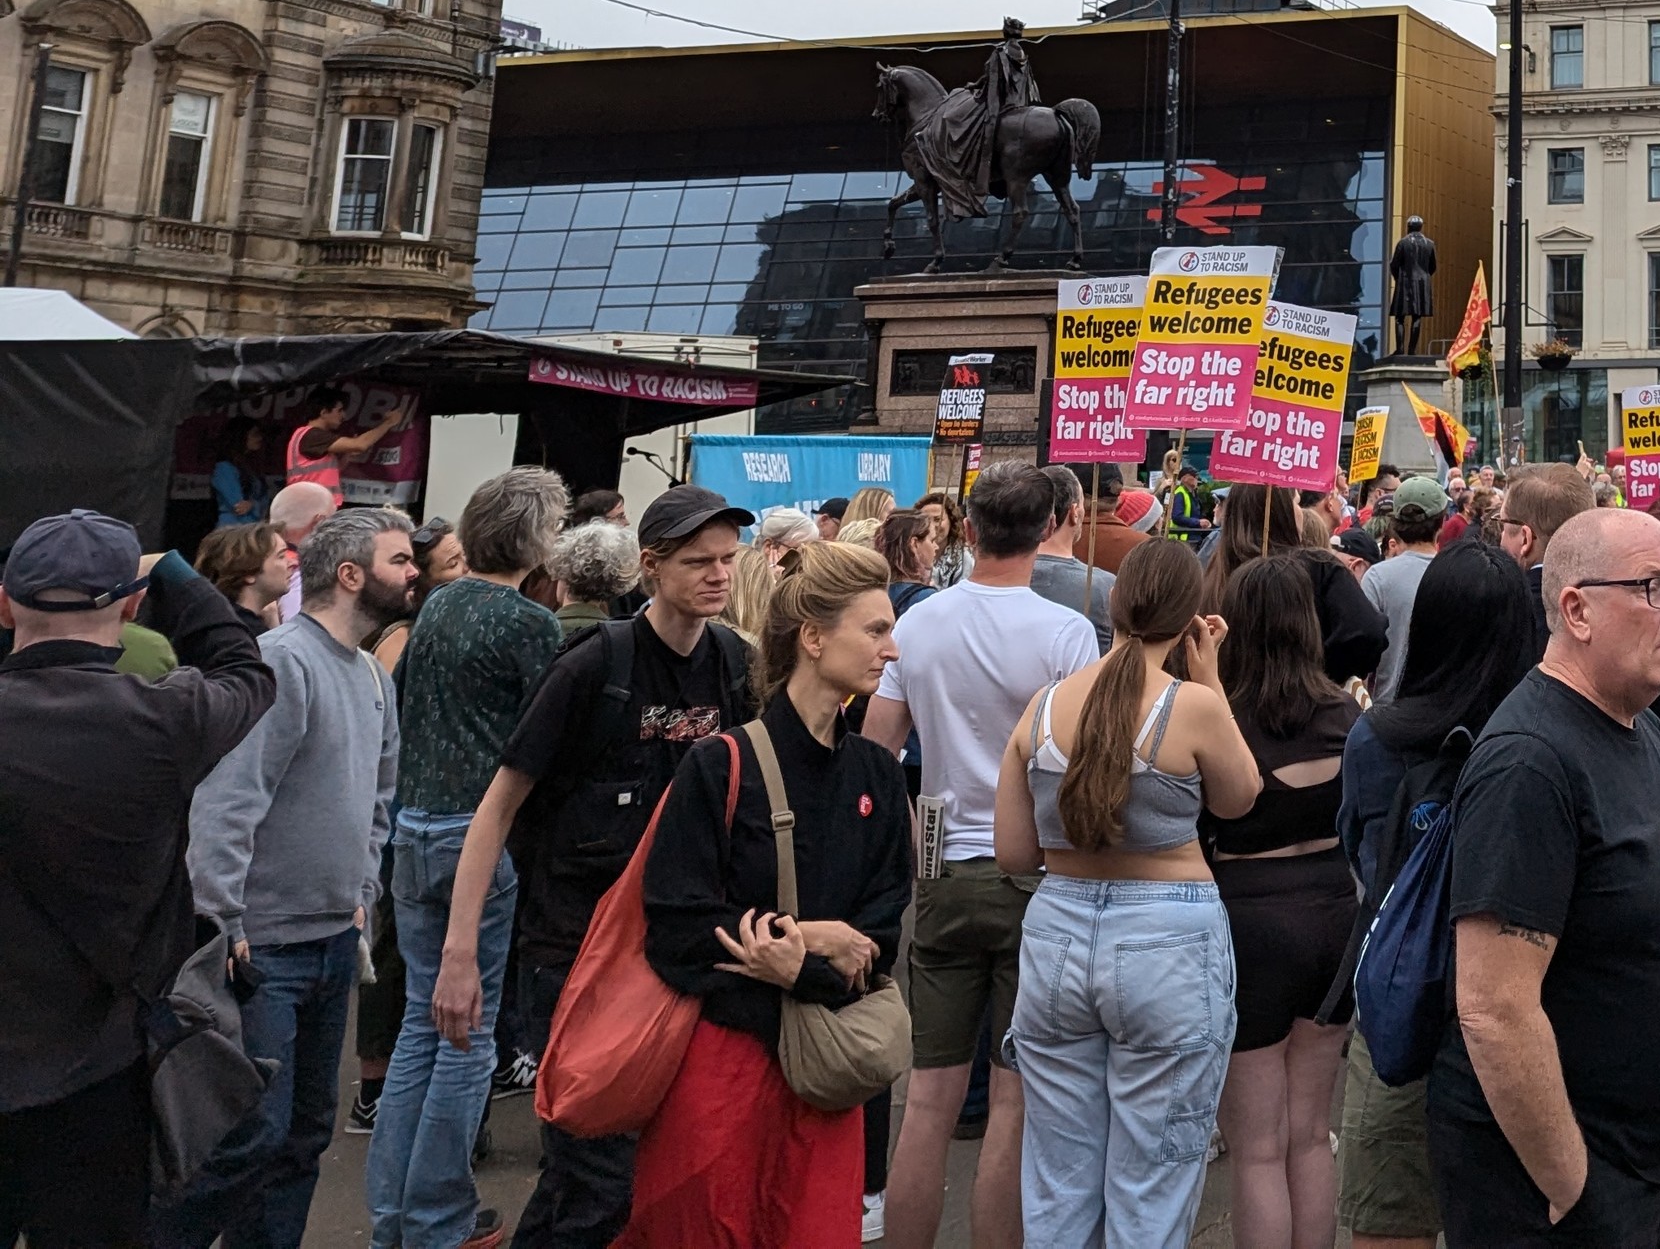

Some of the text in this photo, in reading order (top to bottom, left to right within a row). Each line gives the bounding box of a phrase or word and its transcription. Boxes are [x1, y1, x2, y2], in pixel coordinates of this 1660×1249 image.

[1201, 252, 1246, 262] STAND UP
[1201, 262, 1248, 273] TO RACISM
[1094, 283, 1130, 294] STAND UP
[1094, 292, 1134, 304] TO RACISM
[1153, 280, 1262, 310] Refugees
[1149, 311, 1252, 335] welcome
[1282, 308, 1327, 324] STAND UP
[1282, 319, 1330, 337] TO RACISM
[1140, 348, 1242, 381] Stop the
[1258, 337, 1345, 372] efugees
[556, 363, 727, 400] STAND UP TO RACISM
[1134, 379, 1236, 412] far right
[1253, 365, 1335, 400] elcome
[938, 404, 982, 420] WELCOME
[940, 389, 985, 405] REFUGEES
[1058, 383, 1125, 415] Stop th
[1056, 415, 1134, 446] far right
[1246, 403, 1325, 440] top the
[1220, 431, 1320, 470] far right
[742, 452, 891, 483] RESEARCH LIBRARY
[1631, 481, 1655, 497] far
[926, 806, 936, 844] Star
